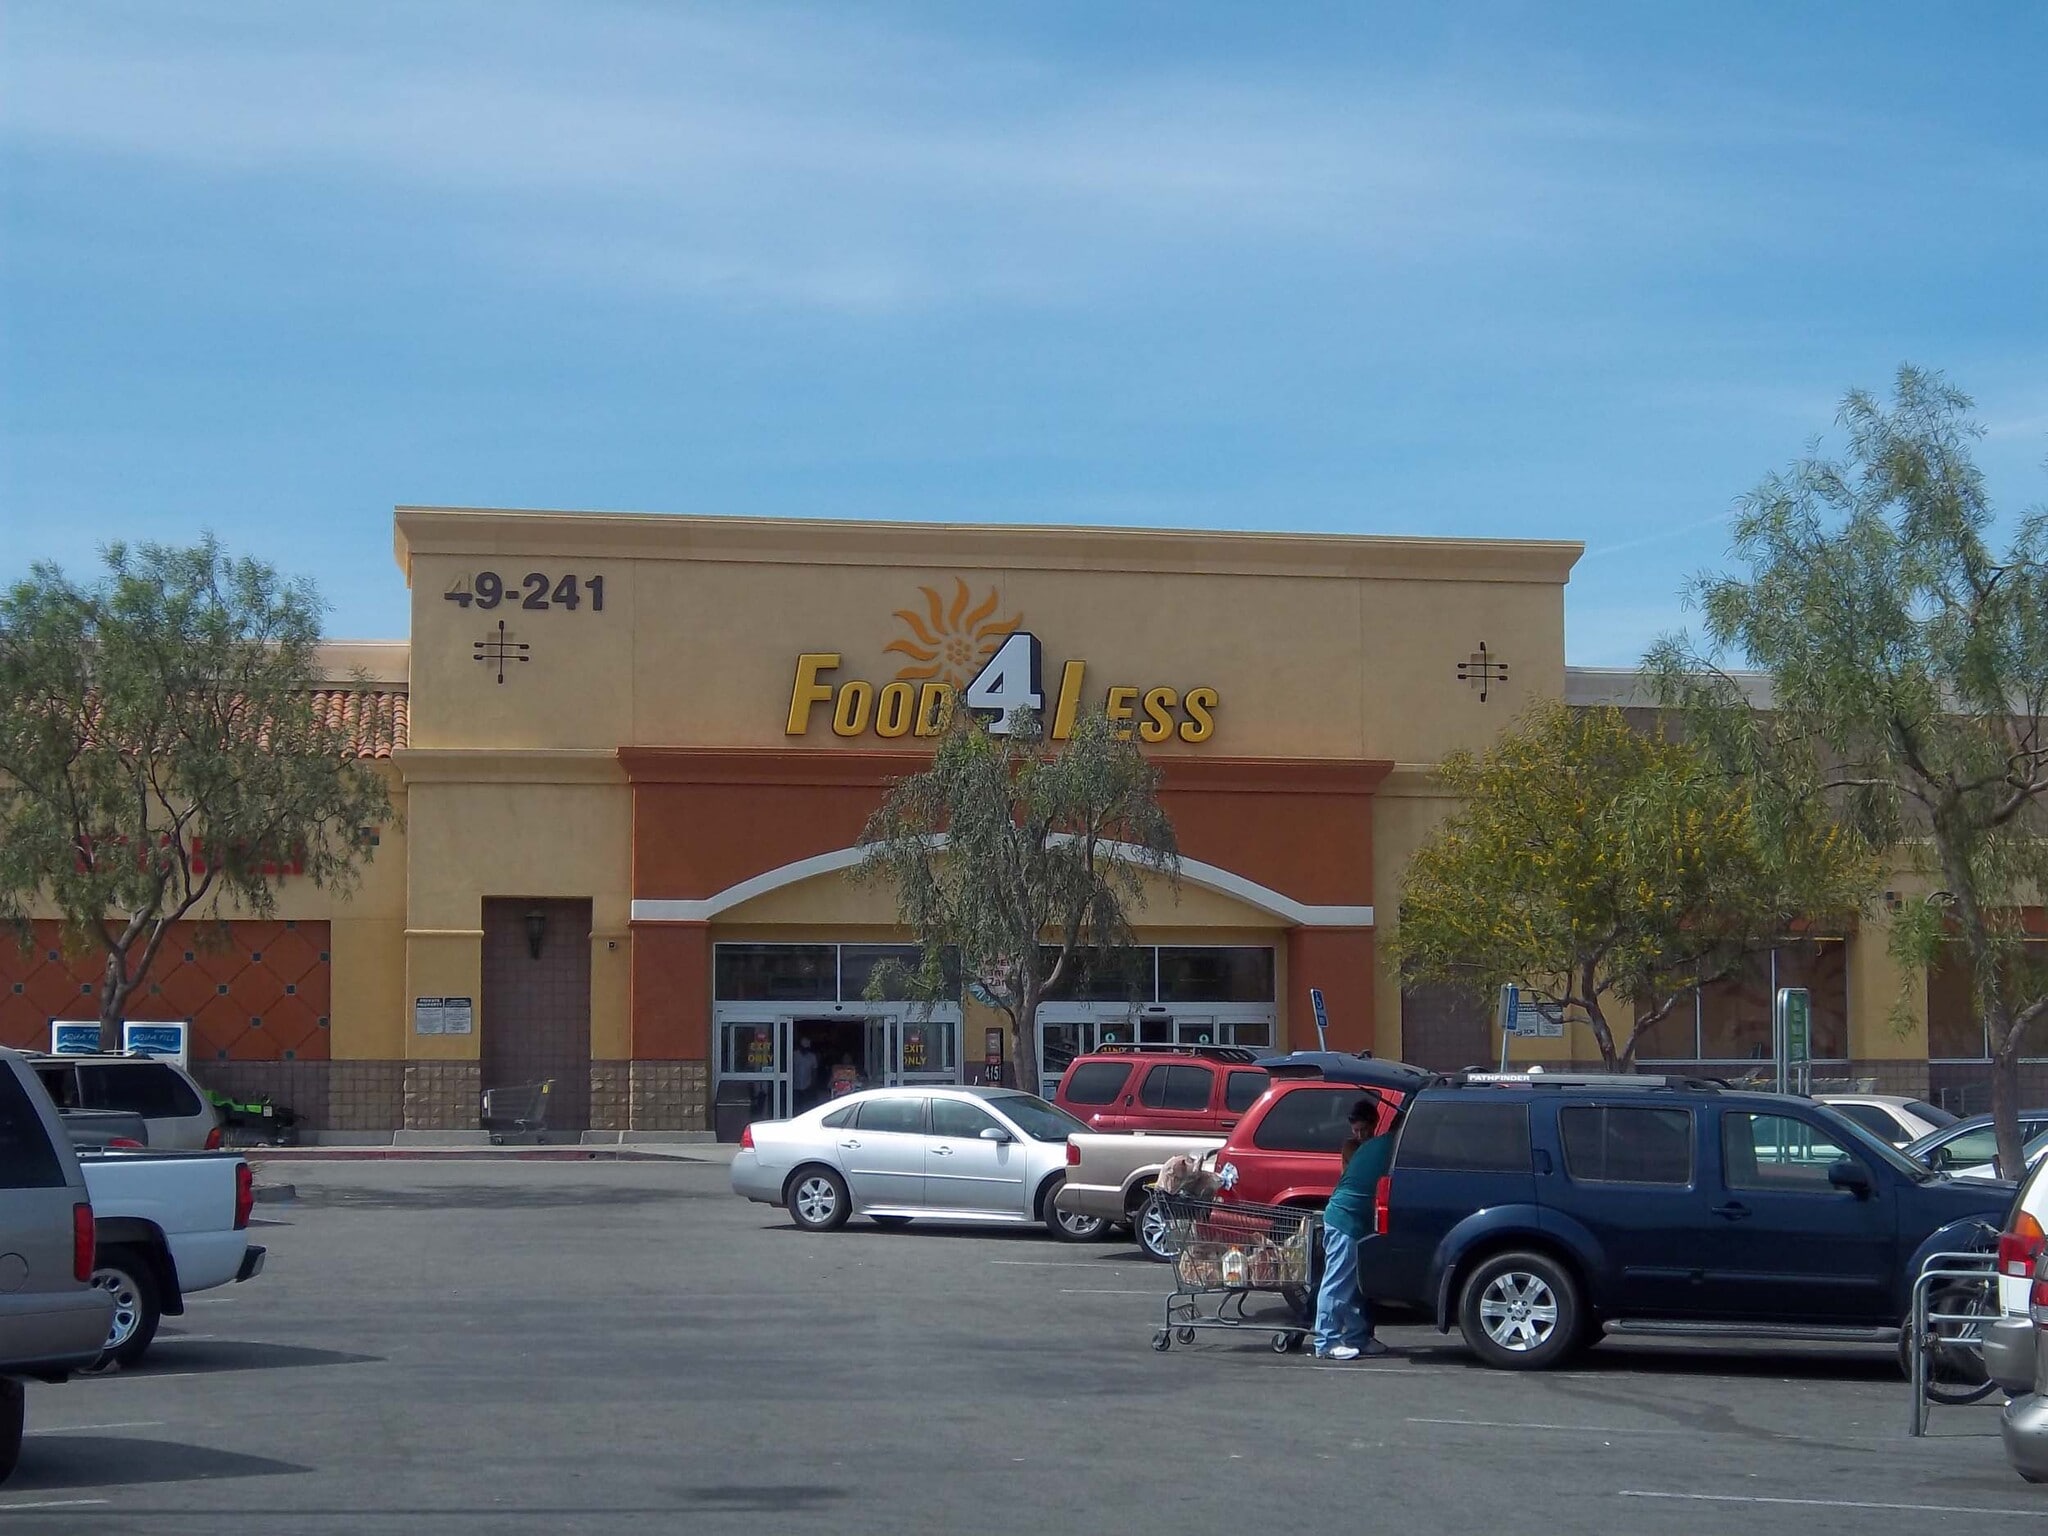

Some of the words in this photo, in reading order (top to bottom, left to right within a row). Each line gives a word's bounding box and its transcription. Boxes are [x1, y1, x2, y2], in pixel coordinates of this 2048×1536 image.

[444, 571, 603, 611] 49-241
[967, 631, 1044, 735] 4
[904, 1044, 925, 1054] EXIT
[1468, 1074, 1531, 1082] PATHFINDER
